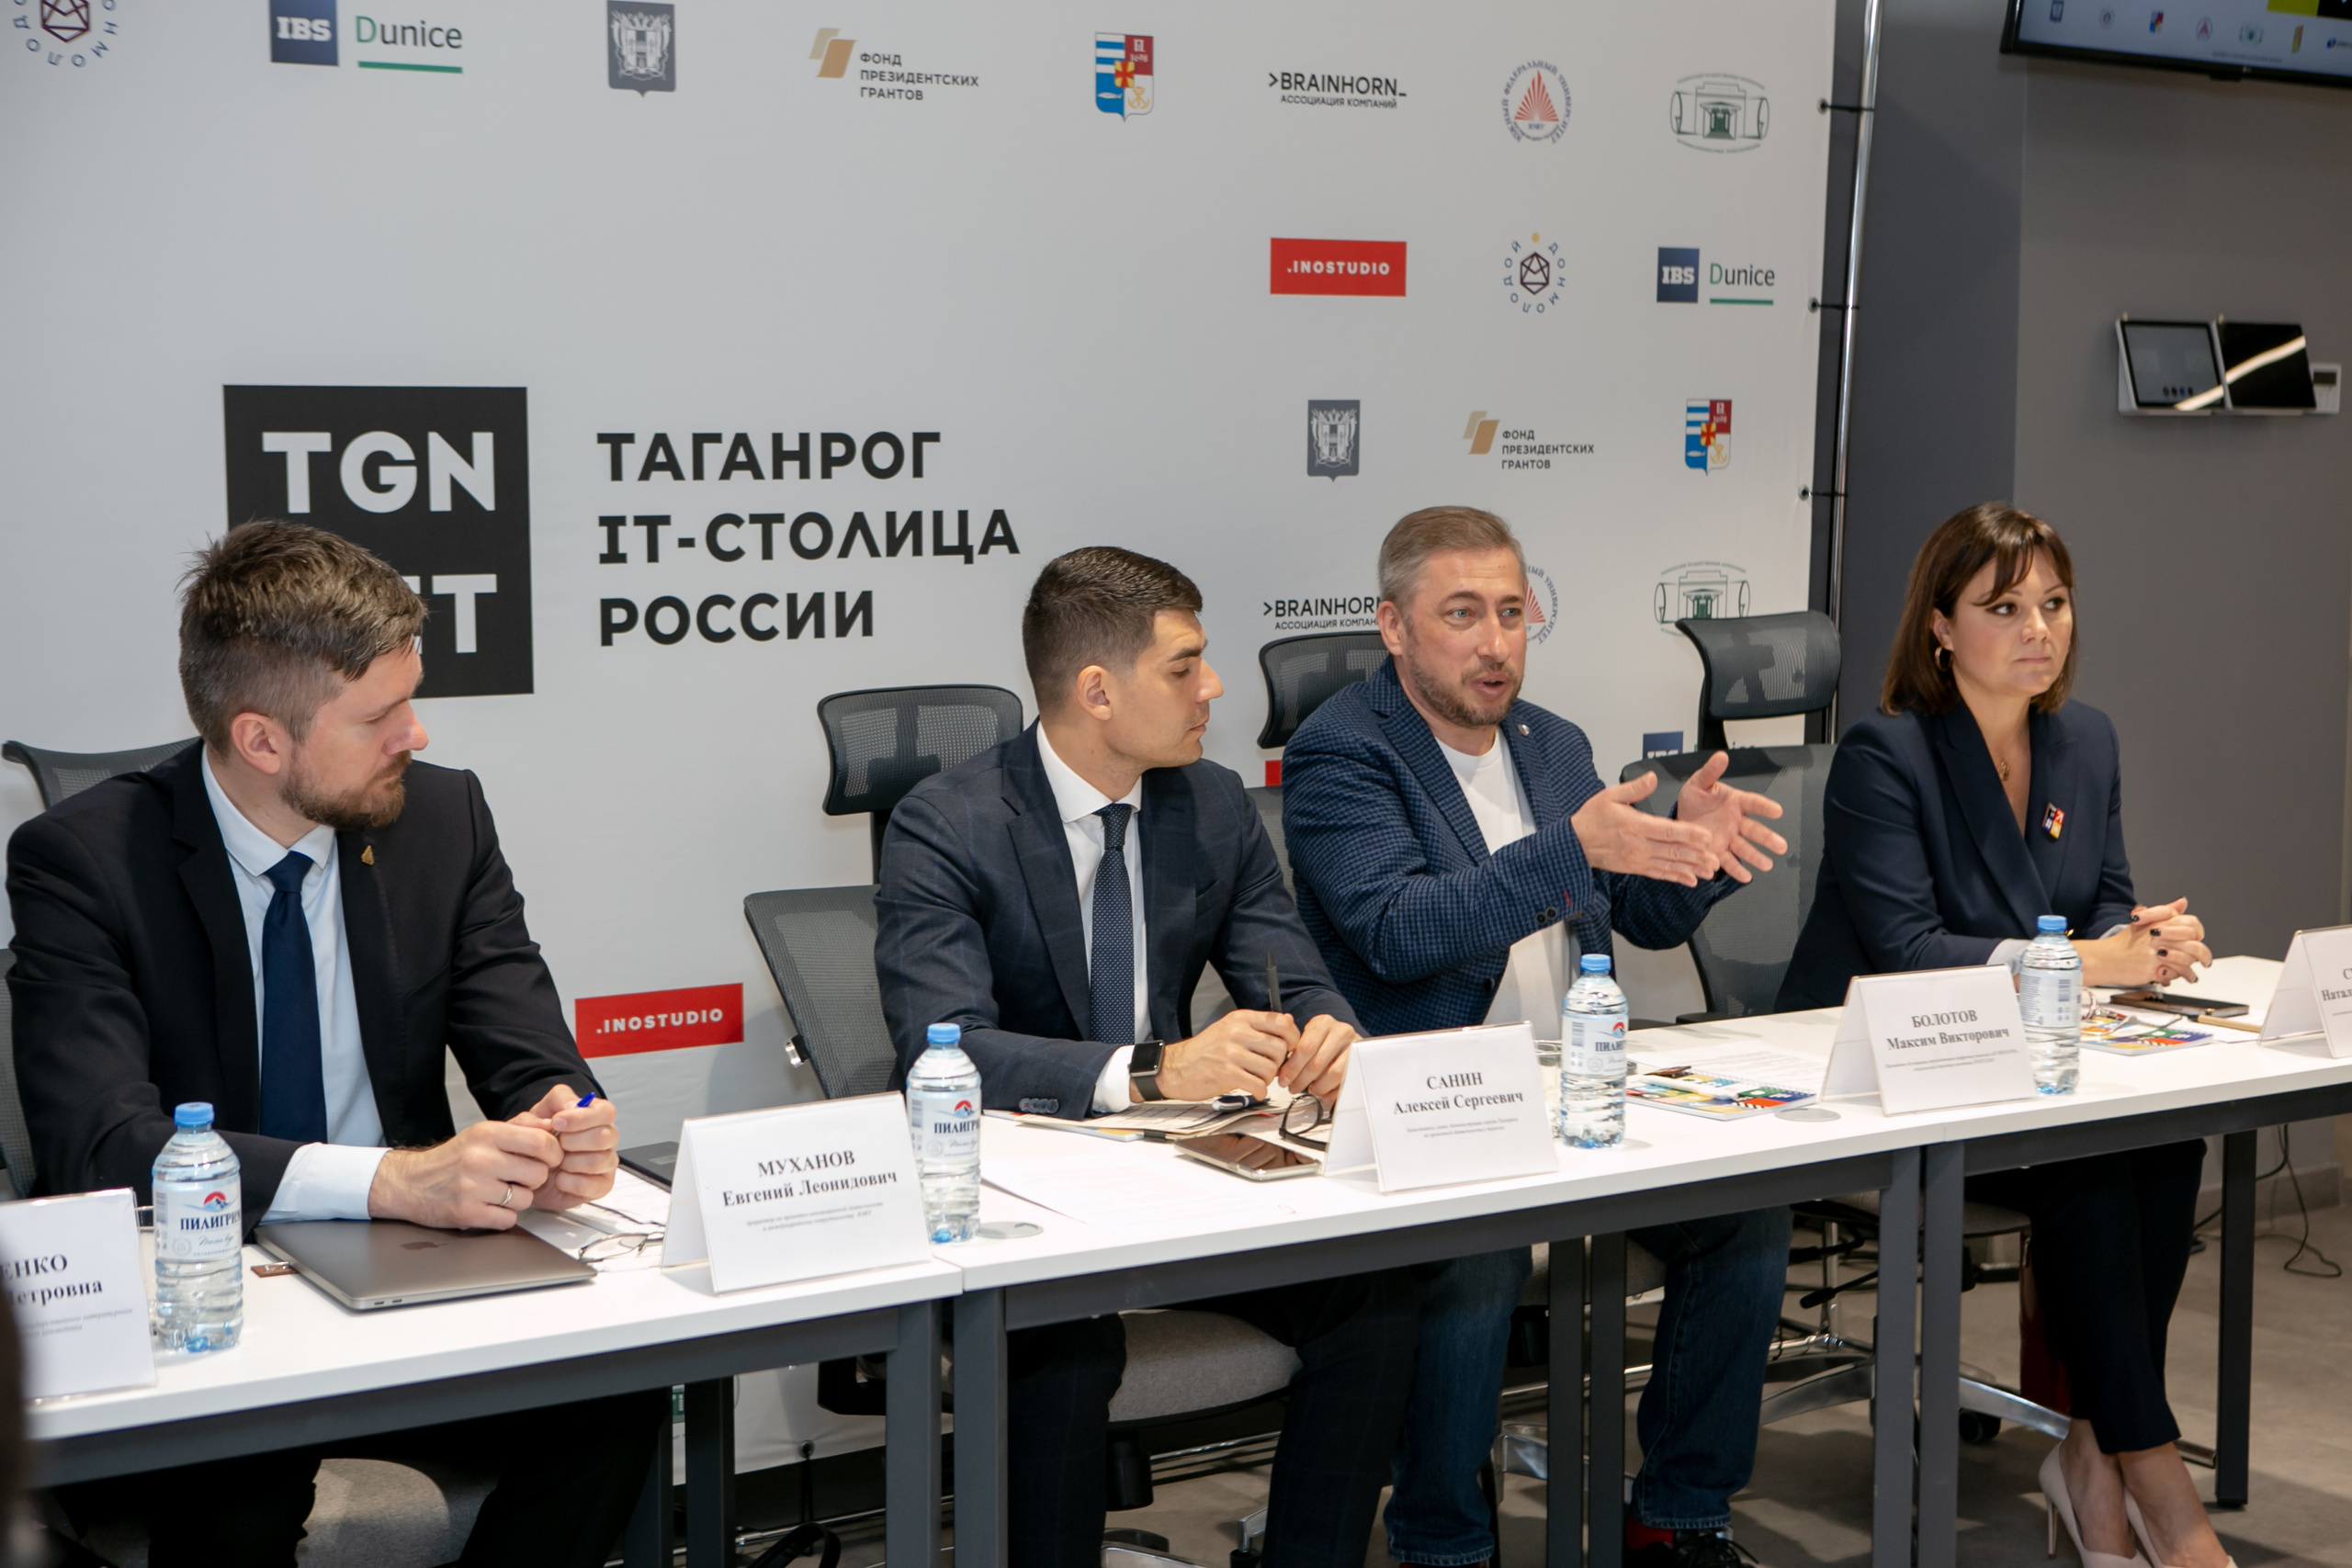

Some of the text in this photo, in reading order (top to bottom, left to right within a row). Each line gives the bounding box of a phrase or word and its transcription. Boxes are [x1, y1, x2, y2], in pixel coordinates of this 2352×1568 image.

[277, 16, 462, 49] IBS Dunice
[860, 52, 902, 67] ФОНД
[860, 70, 979, 87] ПРЕЗИДЕНТСКИХ
[860, 87, 923, 101] ГРАНТОВ
[1281, 95, 1397, 109] АССОЦИАЦИЯ КОМПАНИЙ
[1287, 260, 1390, 276] .INOSTUDIO
[1662, 263, 1775, 287] IBS Dunice
[1502, 430, 1535, 441] ФОНД
[596, 431, 941, 482] ТАГАНРОГ
[1502, 444, 1594, 456] ПРЕЗИДЕНТСКИХ
[261, 431, 496, 513] TGN
[1501, 459, 1551, 470] ГРАНТОВ
[598, 509, 1021, 565] IT-СТОЛИЦА
[599, 590, 873, 647] РОССИИ
[1275, 617, 1377, 630] АССОЦИАЦИЯ КОМПАН
[2343, 968, 2352, 980] С
[596, 1009, 723, 1034] .INOSTUDIO
[1911, 1010, 1978, 1029] БОЛОТОВ
[1887, 1028, 2010, 1051] Максим Викторович
[1427, 1071, 1484, 1090] САНИН
[1394, 1091, 1523, 1115] Алексей Сергеевич
[758, 1149, 856, 1178] МУХАНОВ
[722, 1171, 898, 1208] Евгений Леонидович
[9, 1280, 103, 1306] етровна
